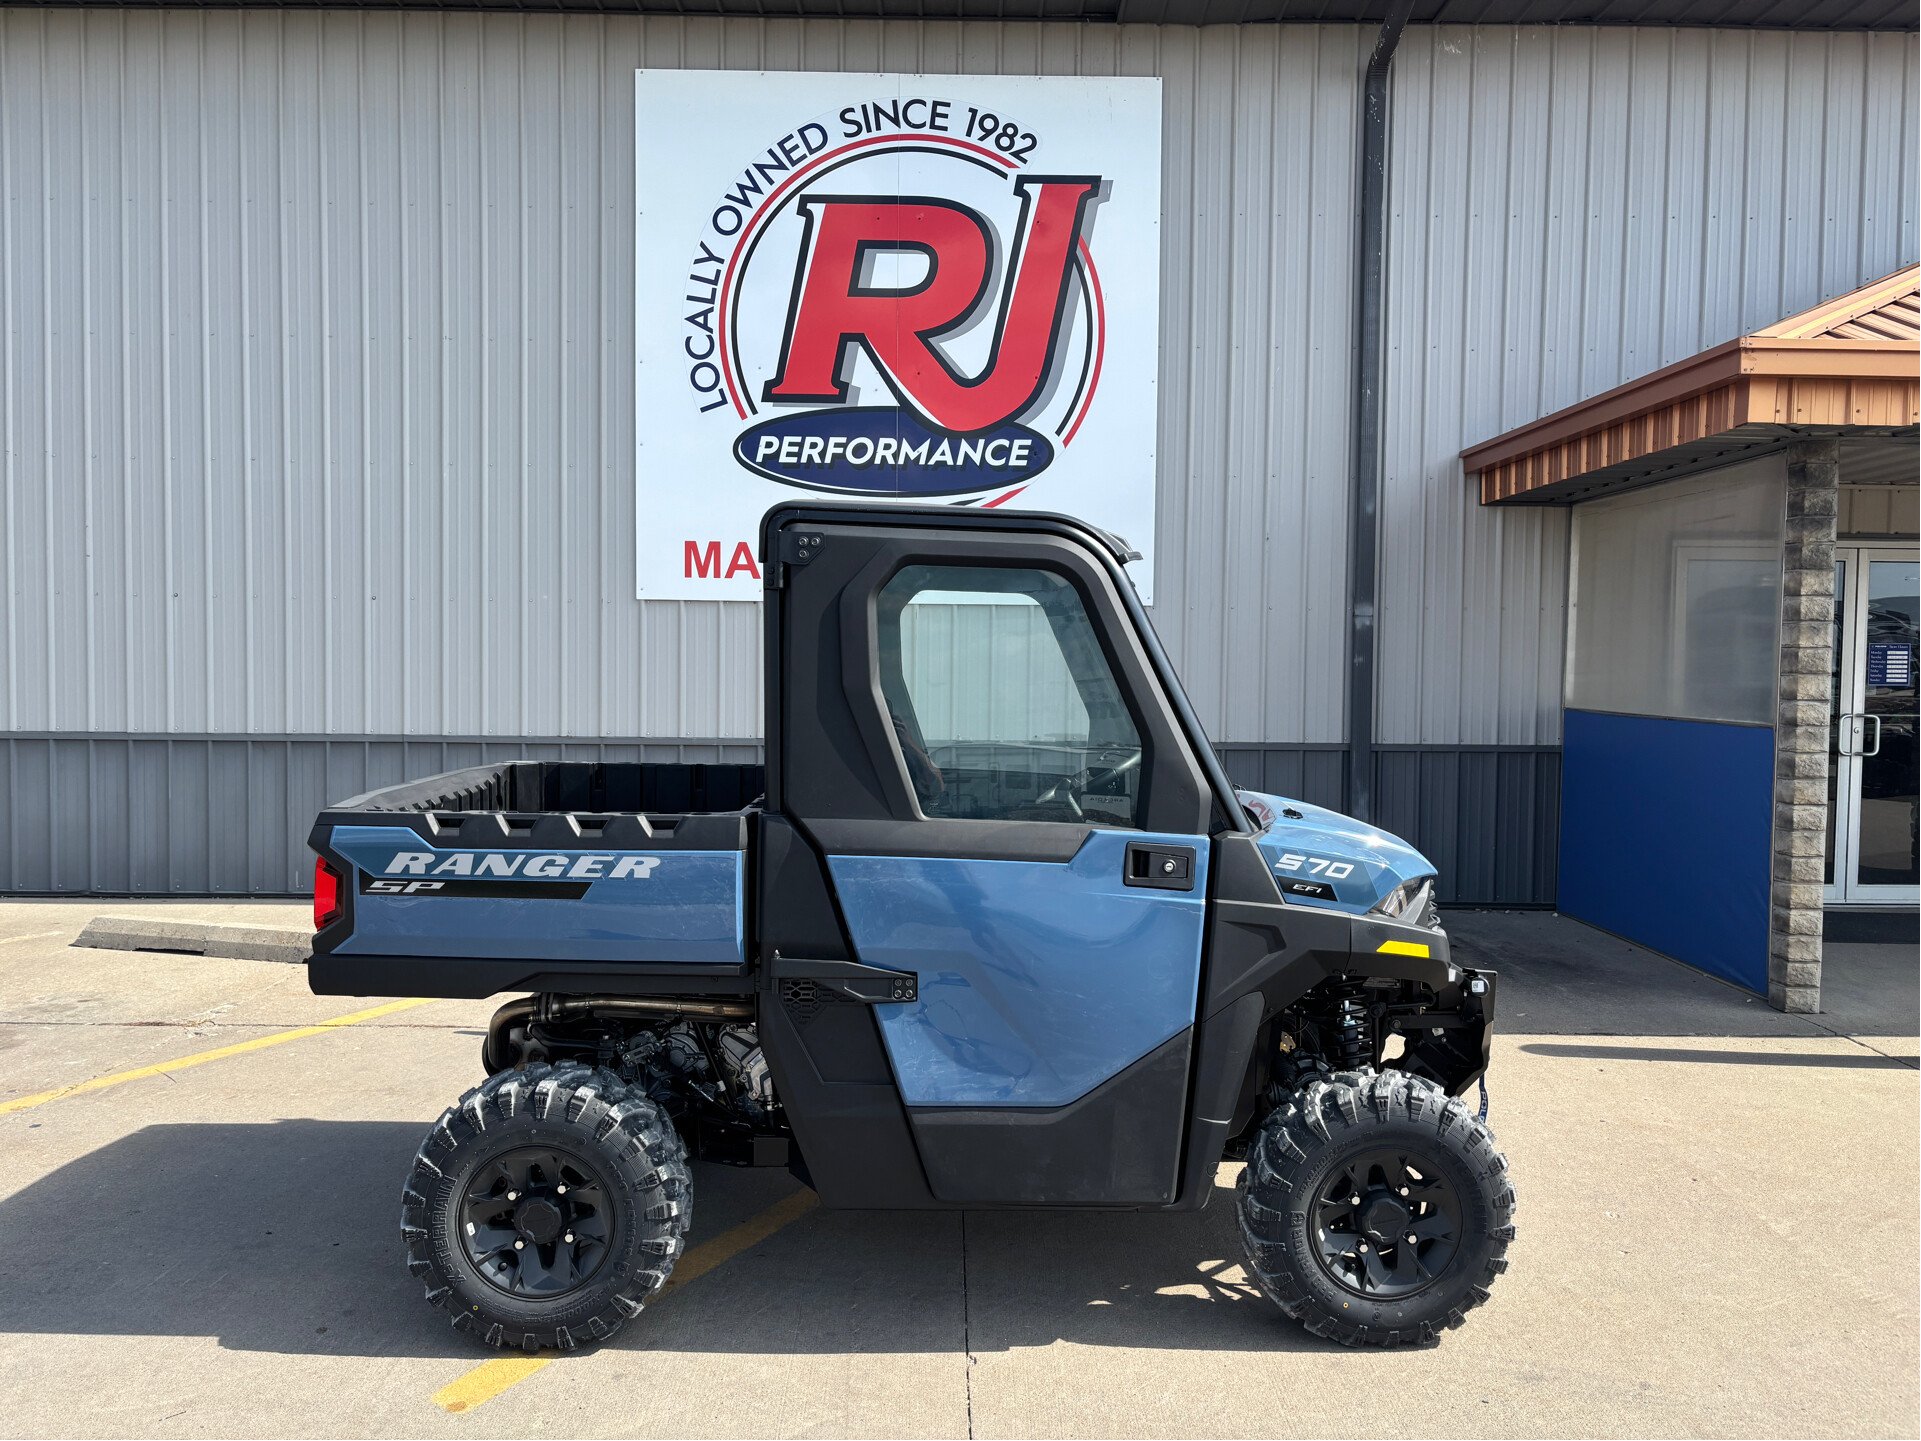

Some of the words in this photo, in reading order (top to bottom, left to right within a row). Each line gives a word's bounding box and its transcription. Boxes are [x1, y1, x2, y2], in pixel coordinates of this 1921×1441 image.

[684, 240, 729, 413] LOCALLY
[712, 122, 829, 237] OWNED
[839, 98, 952, 138] SINCE
[965, 106, 1038, 165] 1982
[761, 174, 1104, 438] RJ
[755, 435, 1034, 468] PERFORMANCE
[684, 540, 762, 579] MA
[383, 851, 661, 879] RANGER
[1273, 853, 1355, 879] 570
[365, 880, 446, 893] SP
[1292, 883, 1322, 893] EFI
[432, 1175, 467, 1287] X-TERRAIN
